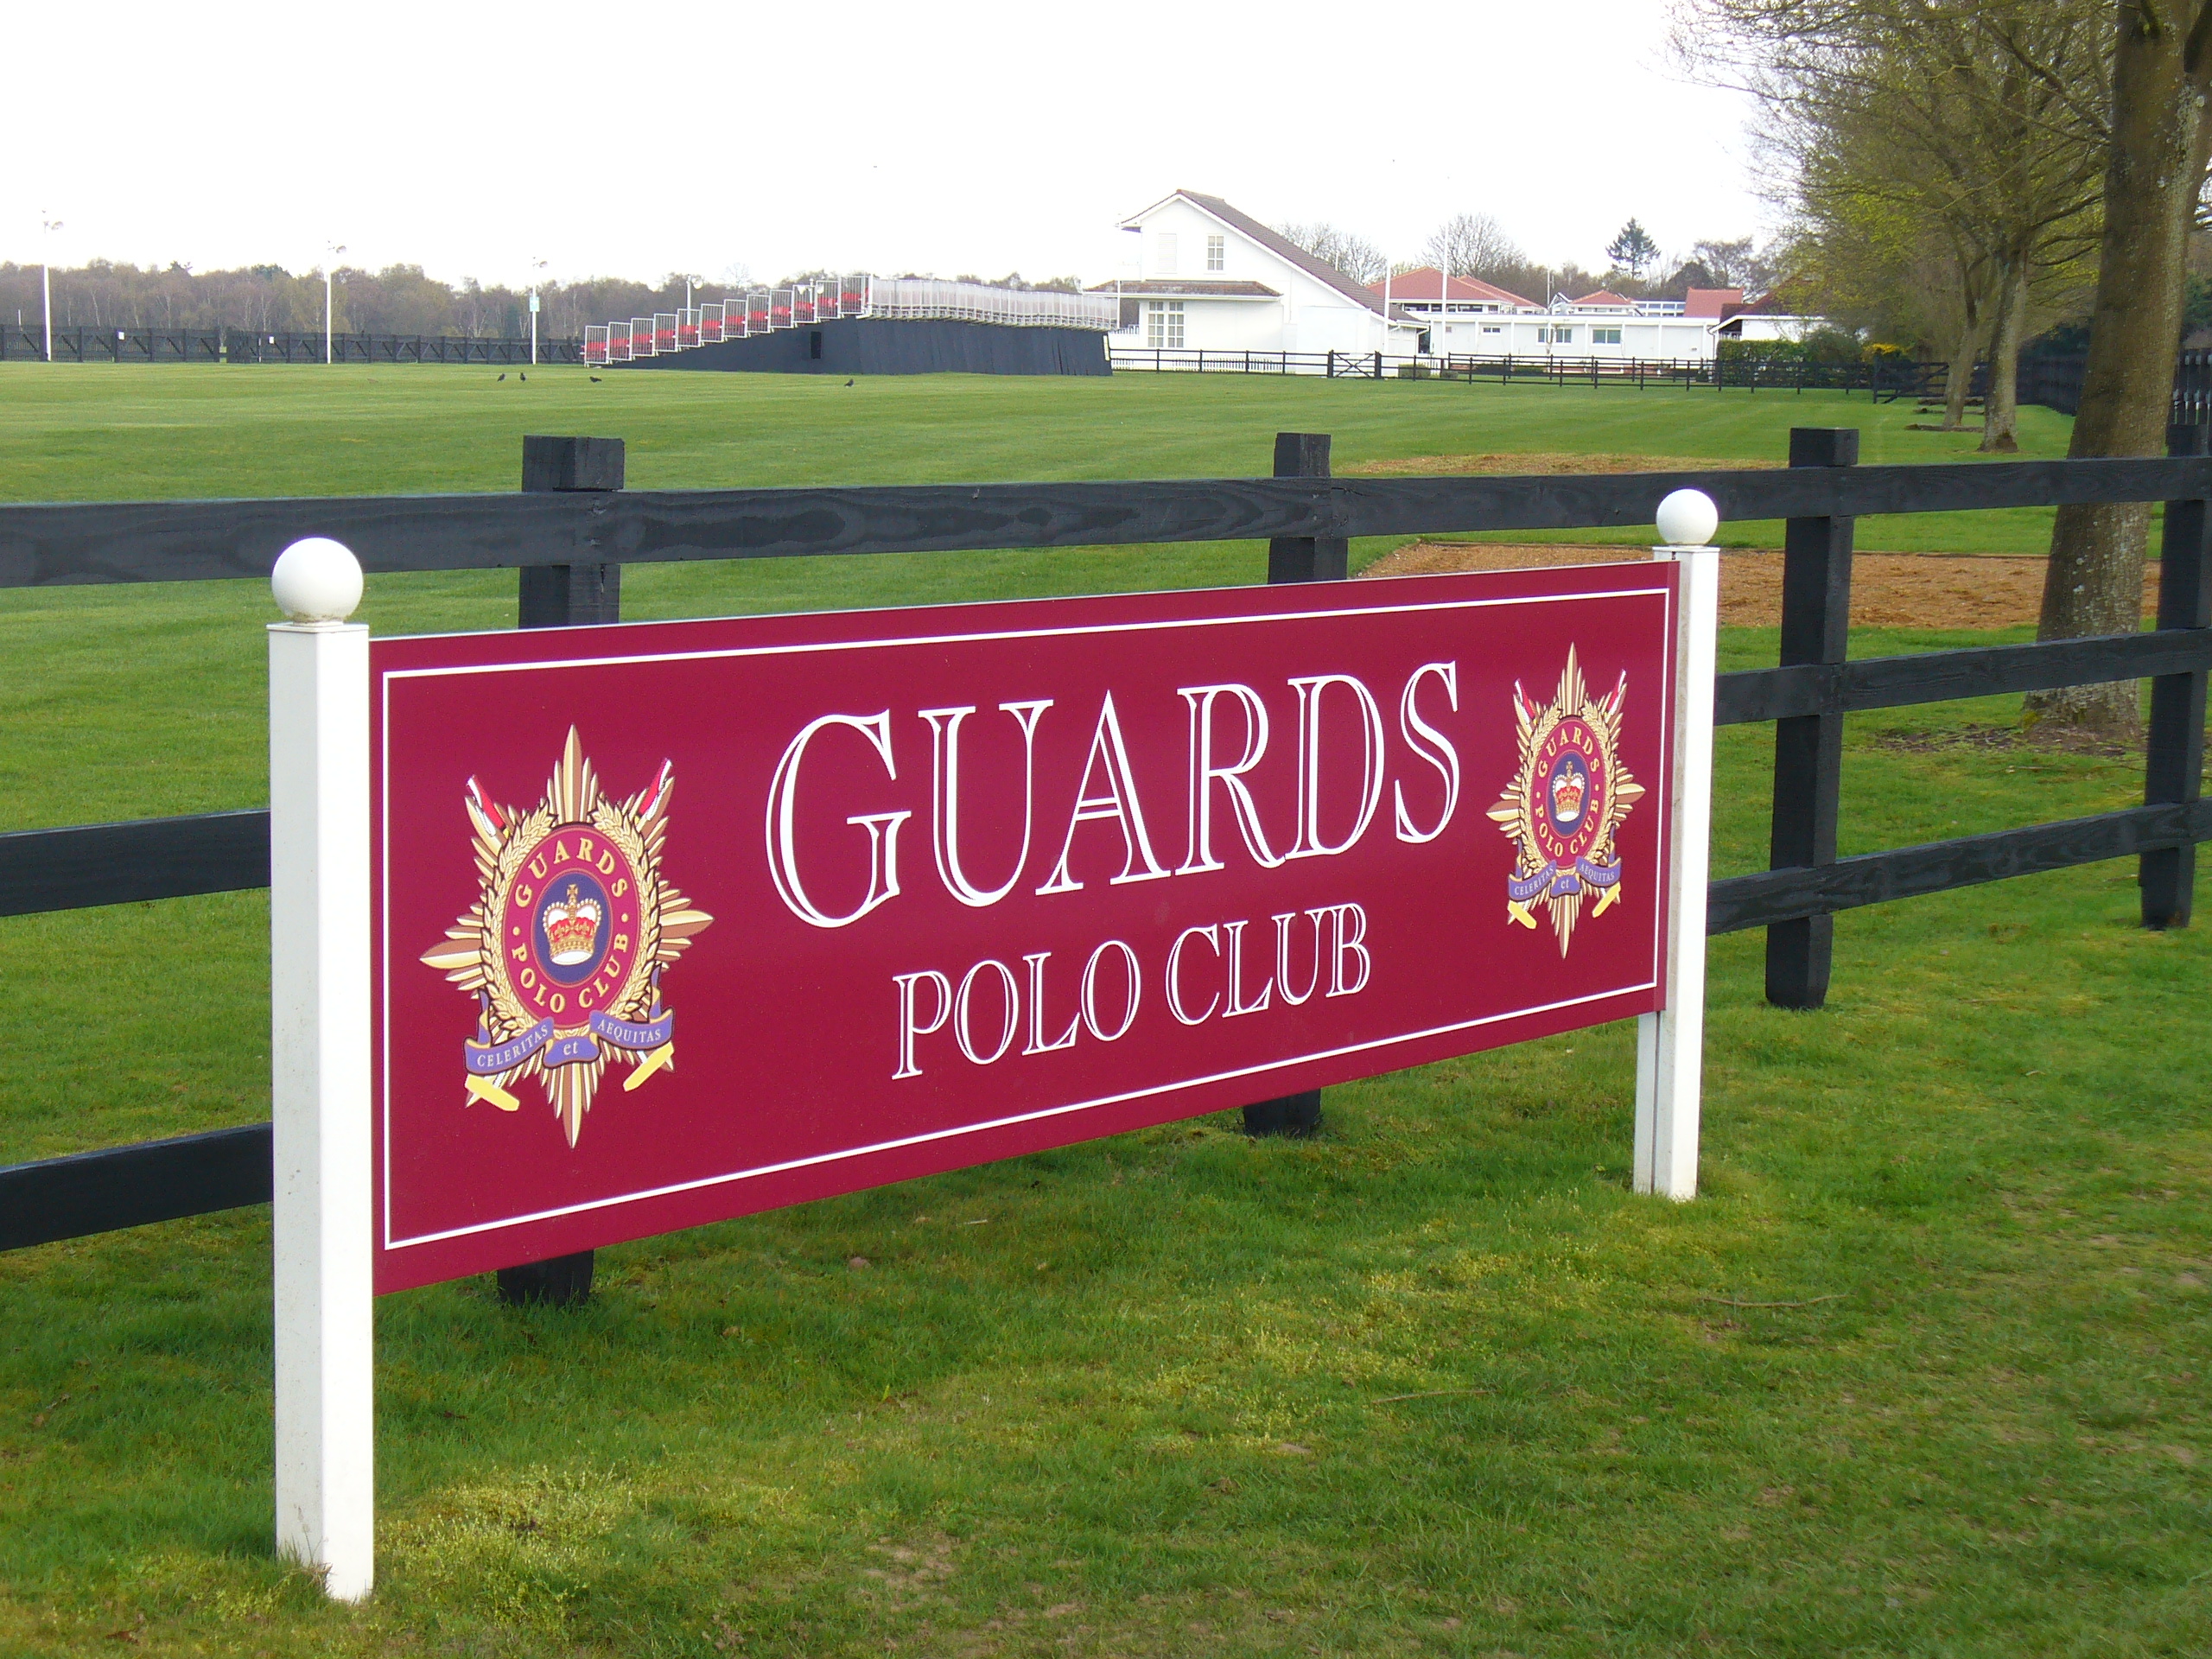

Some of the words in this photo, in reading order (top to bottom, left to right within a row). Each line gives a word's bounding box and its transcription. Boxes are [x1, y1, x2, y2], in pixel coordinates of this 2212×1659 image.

[1537, 726, 1600, 779] GUARDS
[765, 660, 1460, 929] GUARDS
[1535, 804, 1564, 857] POLO
[1569, 798, 1599, 855] CLUB
[516, 836, 628, 908] GUARDS
[1513, 864, 1554, 897] CELERITAS
[1579, 862, 1616, 882] AEQUITAS
[512, 943, 566, 1014] POLO
[578, 931, 629, 1007] CLUB
[890, 939, 1141, 1081] POLO
[1165, 902, 1371, 1027] CLUB
[476, 1024, 550, 1069] CELERITAS
[563, 1039, 580, 1056] et
[597, 1018, 662, 1044] AEQUITAS
